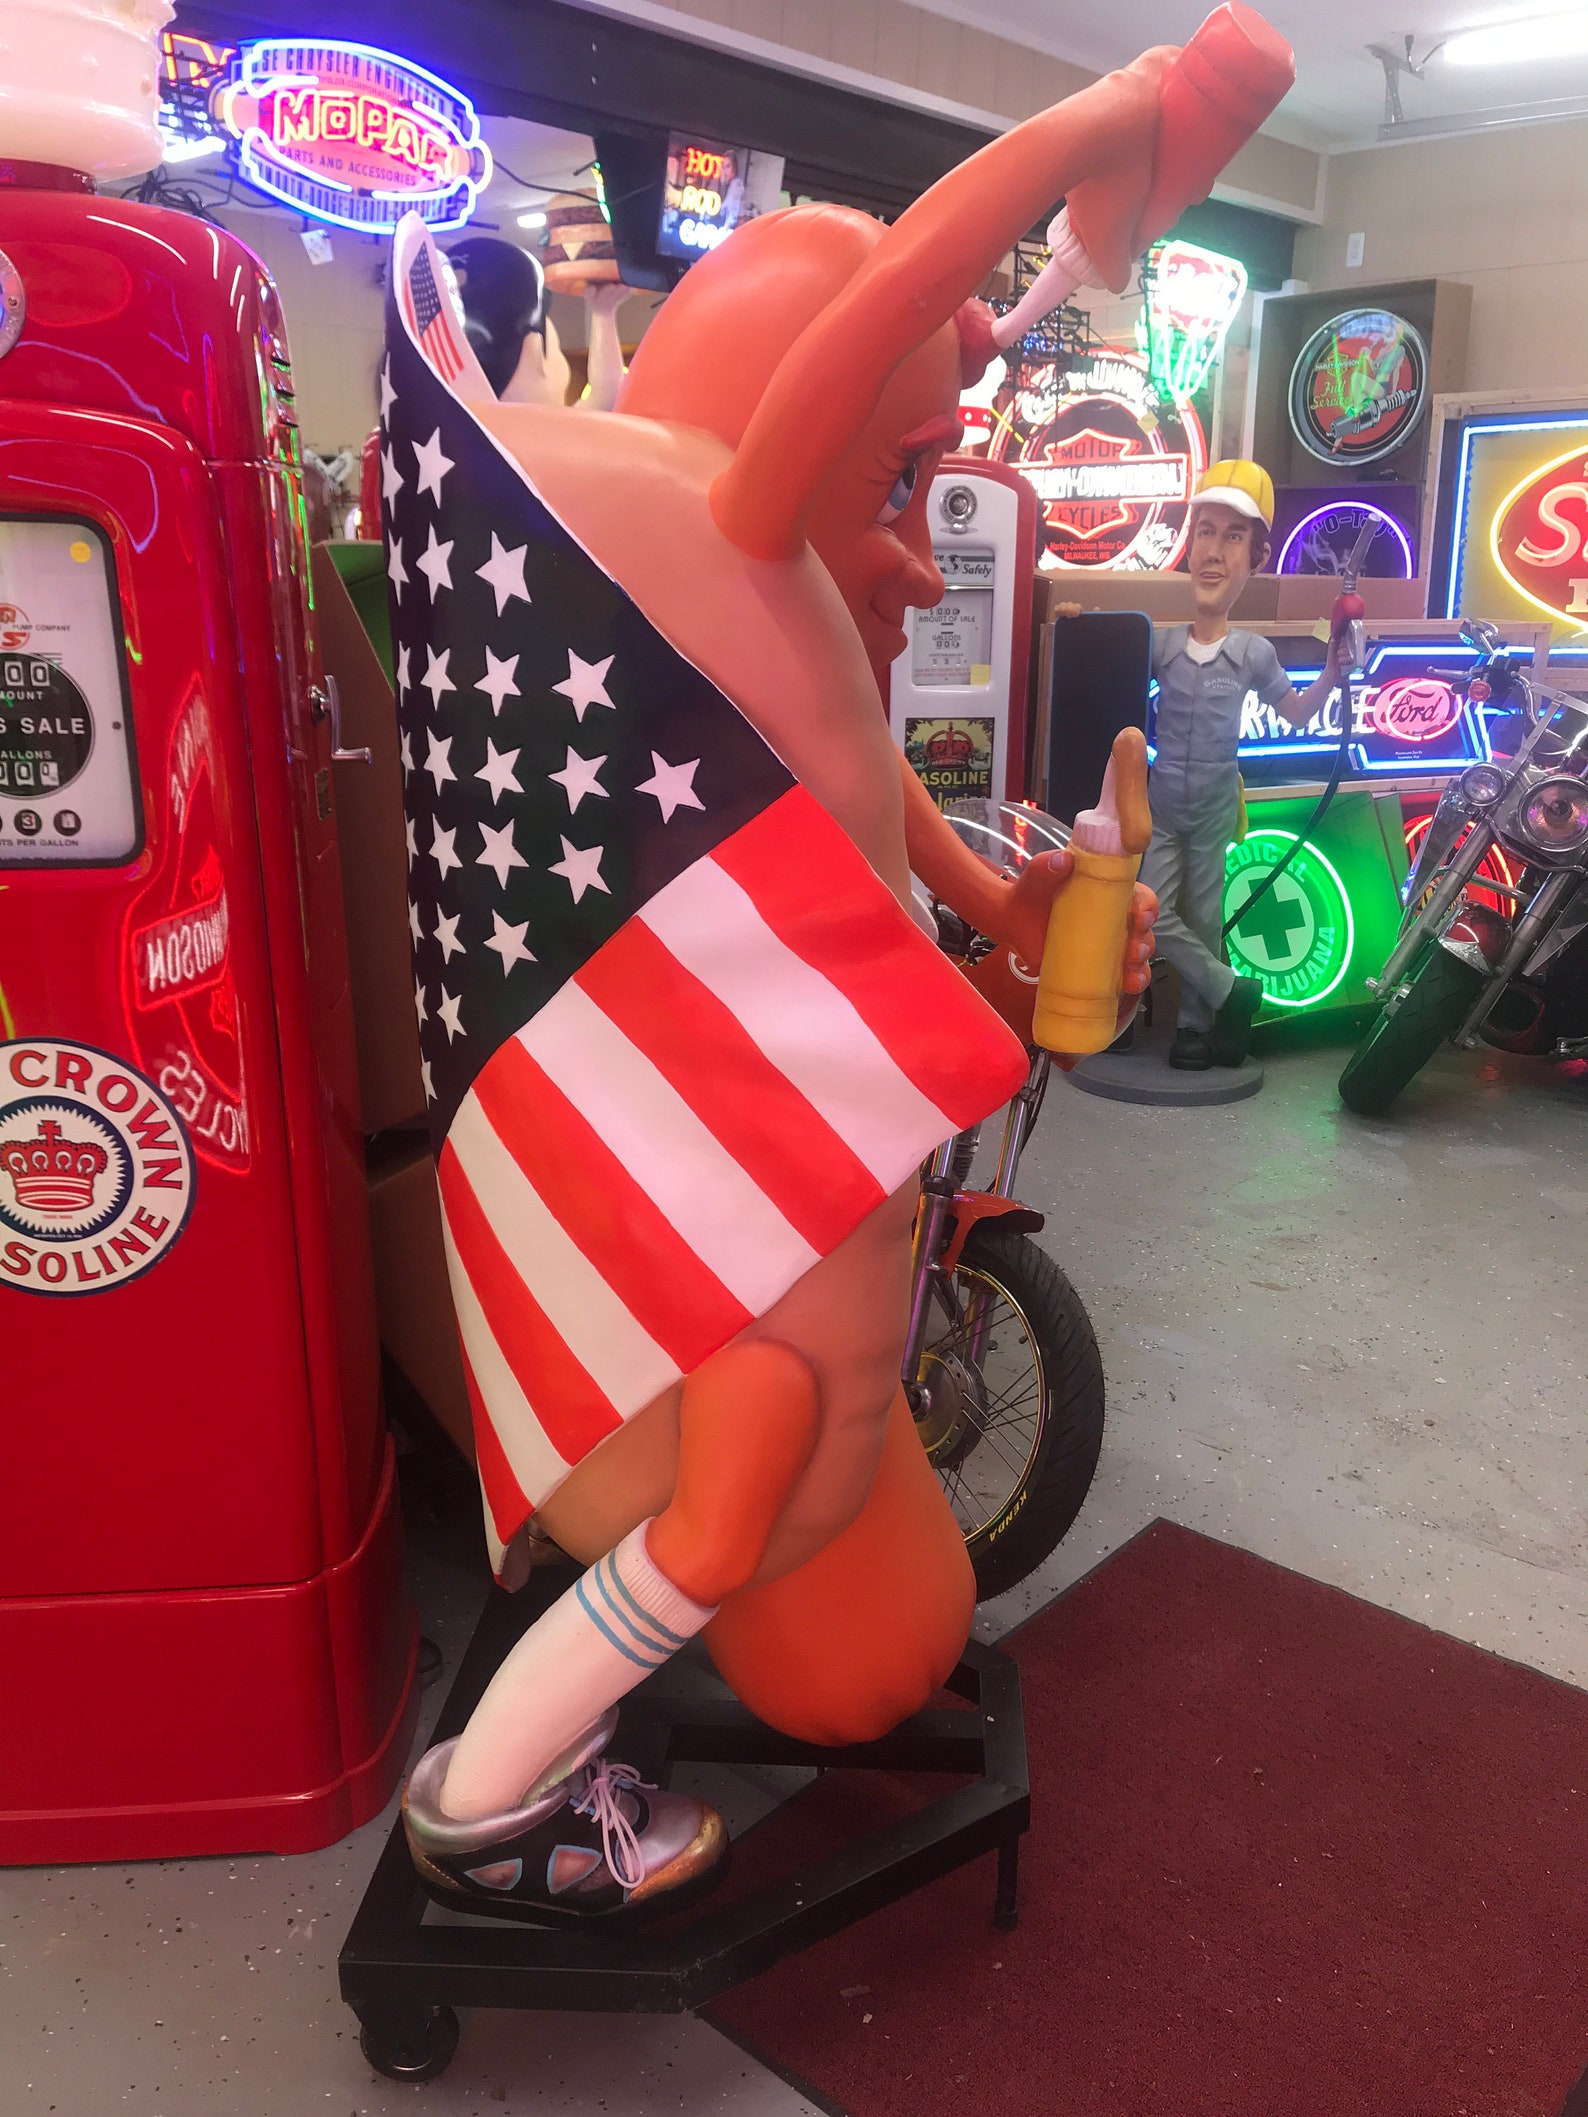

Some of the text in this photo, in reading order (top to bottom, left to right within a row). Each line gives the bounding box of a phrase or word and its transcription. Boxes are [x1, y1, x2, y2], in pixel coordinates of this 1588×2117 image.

[286, 47, 359, 78] CHRYSLER
[273, 88, 453, 182] MOPAR
[319, 155, 343, 170] AND
[348, 161, 418, 187] ACCESSORIES
[685, 146, 727, 180] HOT
[680, 185, 722, 217] ROD
[961, 563, 993, 578] Safely
[35, 624, 70, 633] COMPANY
[1380, 687, 1444, 723] Ford
[20, 716, 86, 735] SALE
[919, 770, 989, 786] ASOLINE
[40, 839, 79, 847] GALLON
[9, 1049, 183, 1191] CROWN
[989, 1489, 1027, 1542] KENDA
